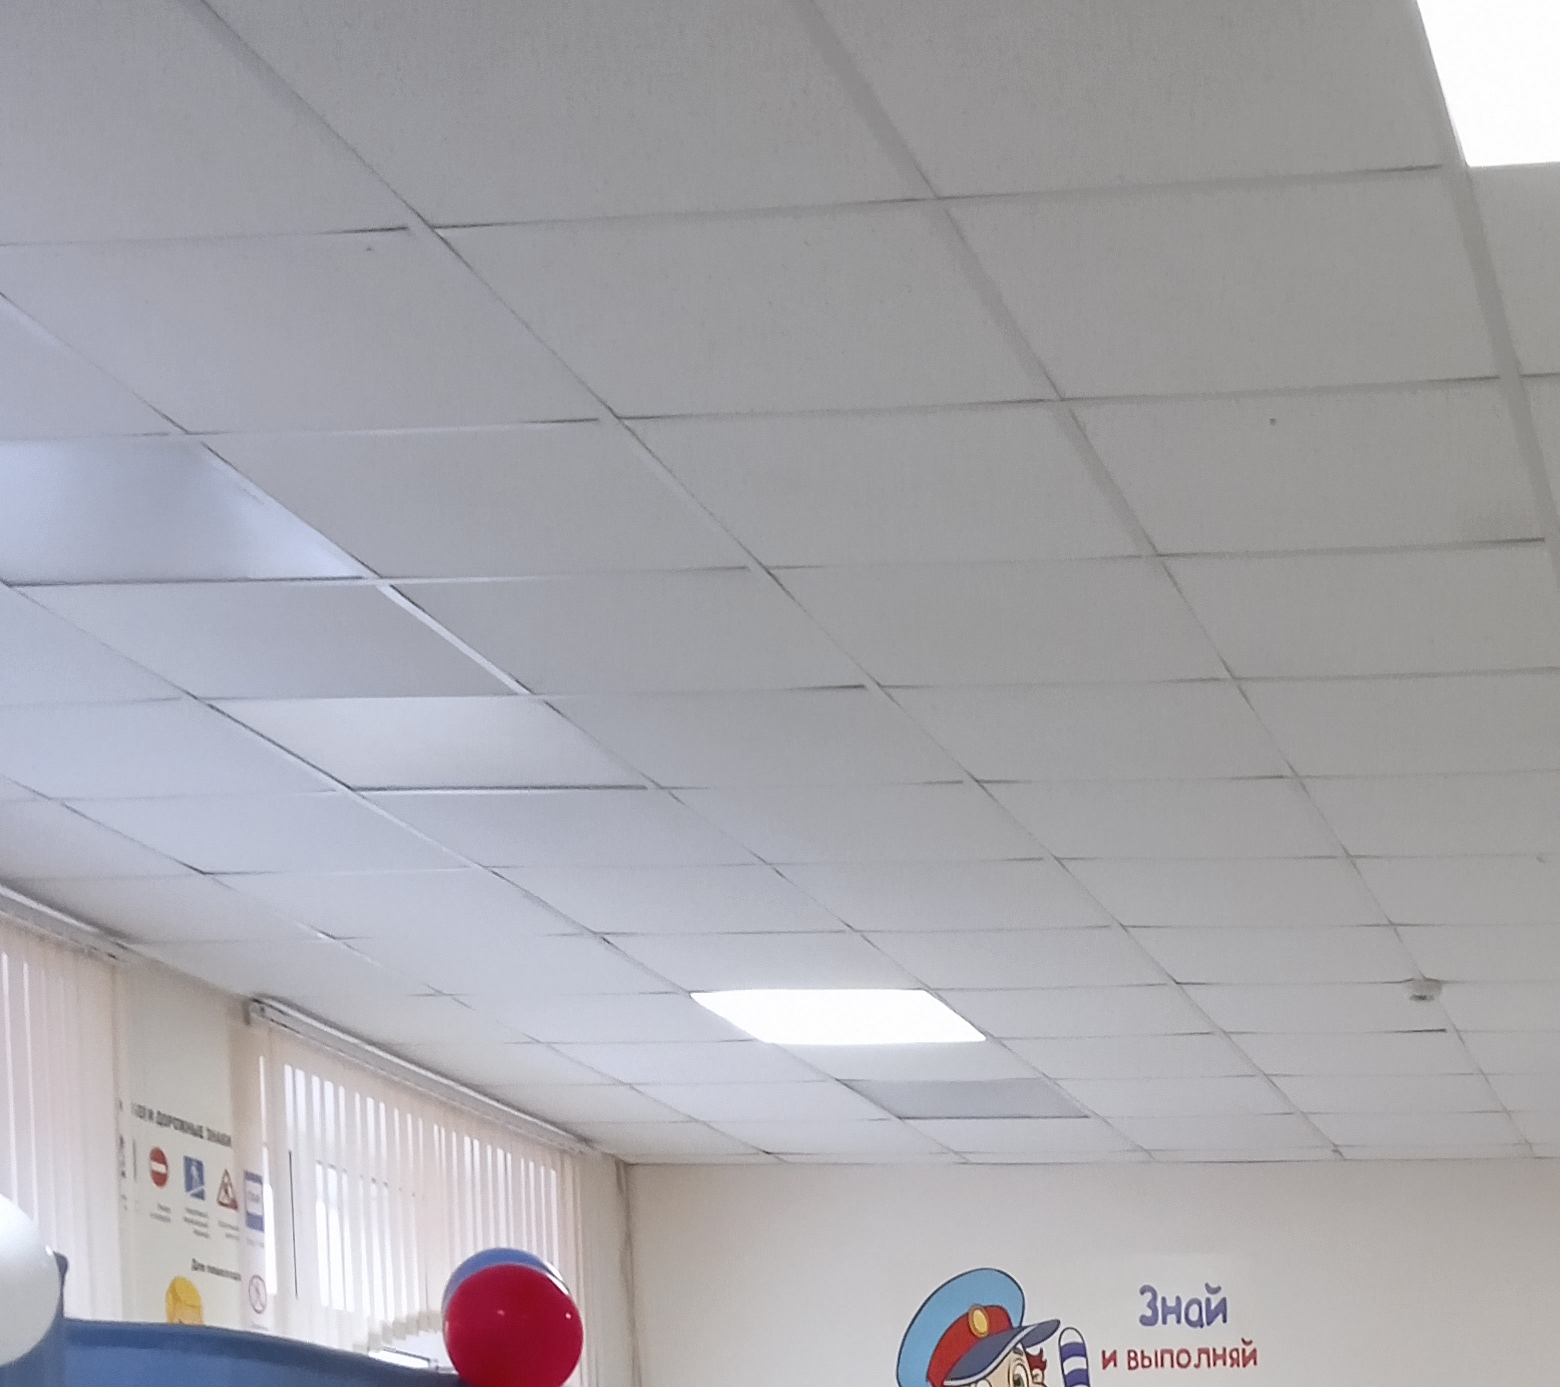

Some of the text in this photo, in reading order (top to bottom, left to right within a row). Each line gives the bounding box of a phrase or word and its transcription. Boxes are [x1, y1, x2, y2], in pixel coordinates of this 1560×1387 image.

[1138, 1282, 1228, 1328] Знай
[1101, 1337, 1258, 1371] и выполняй
